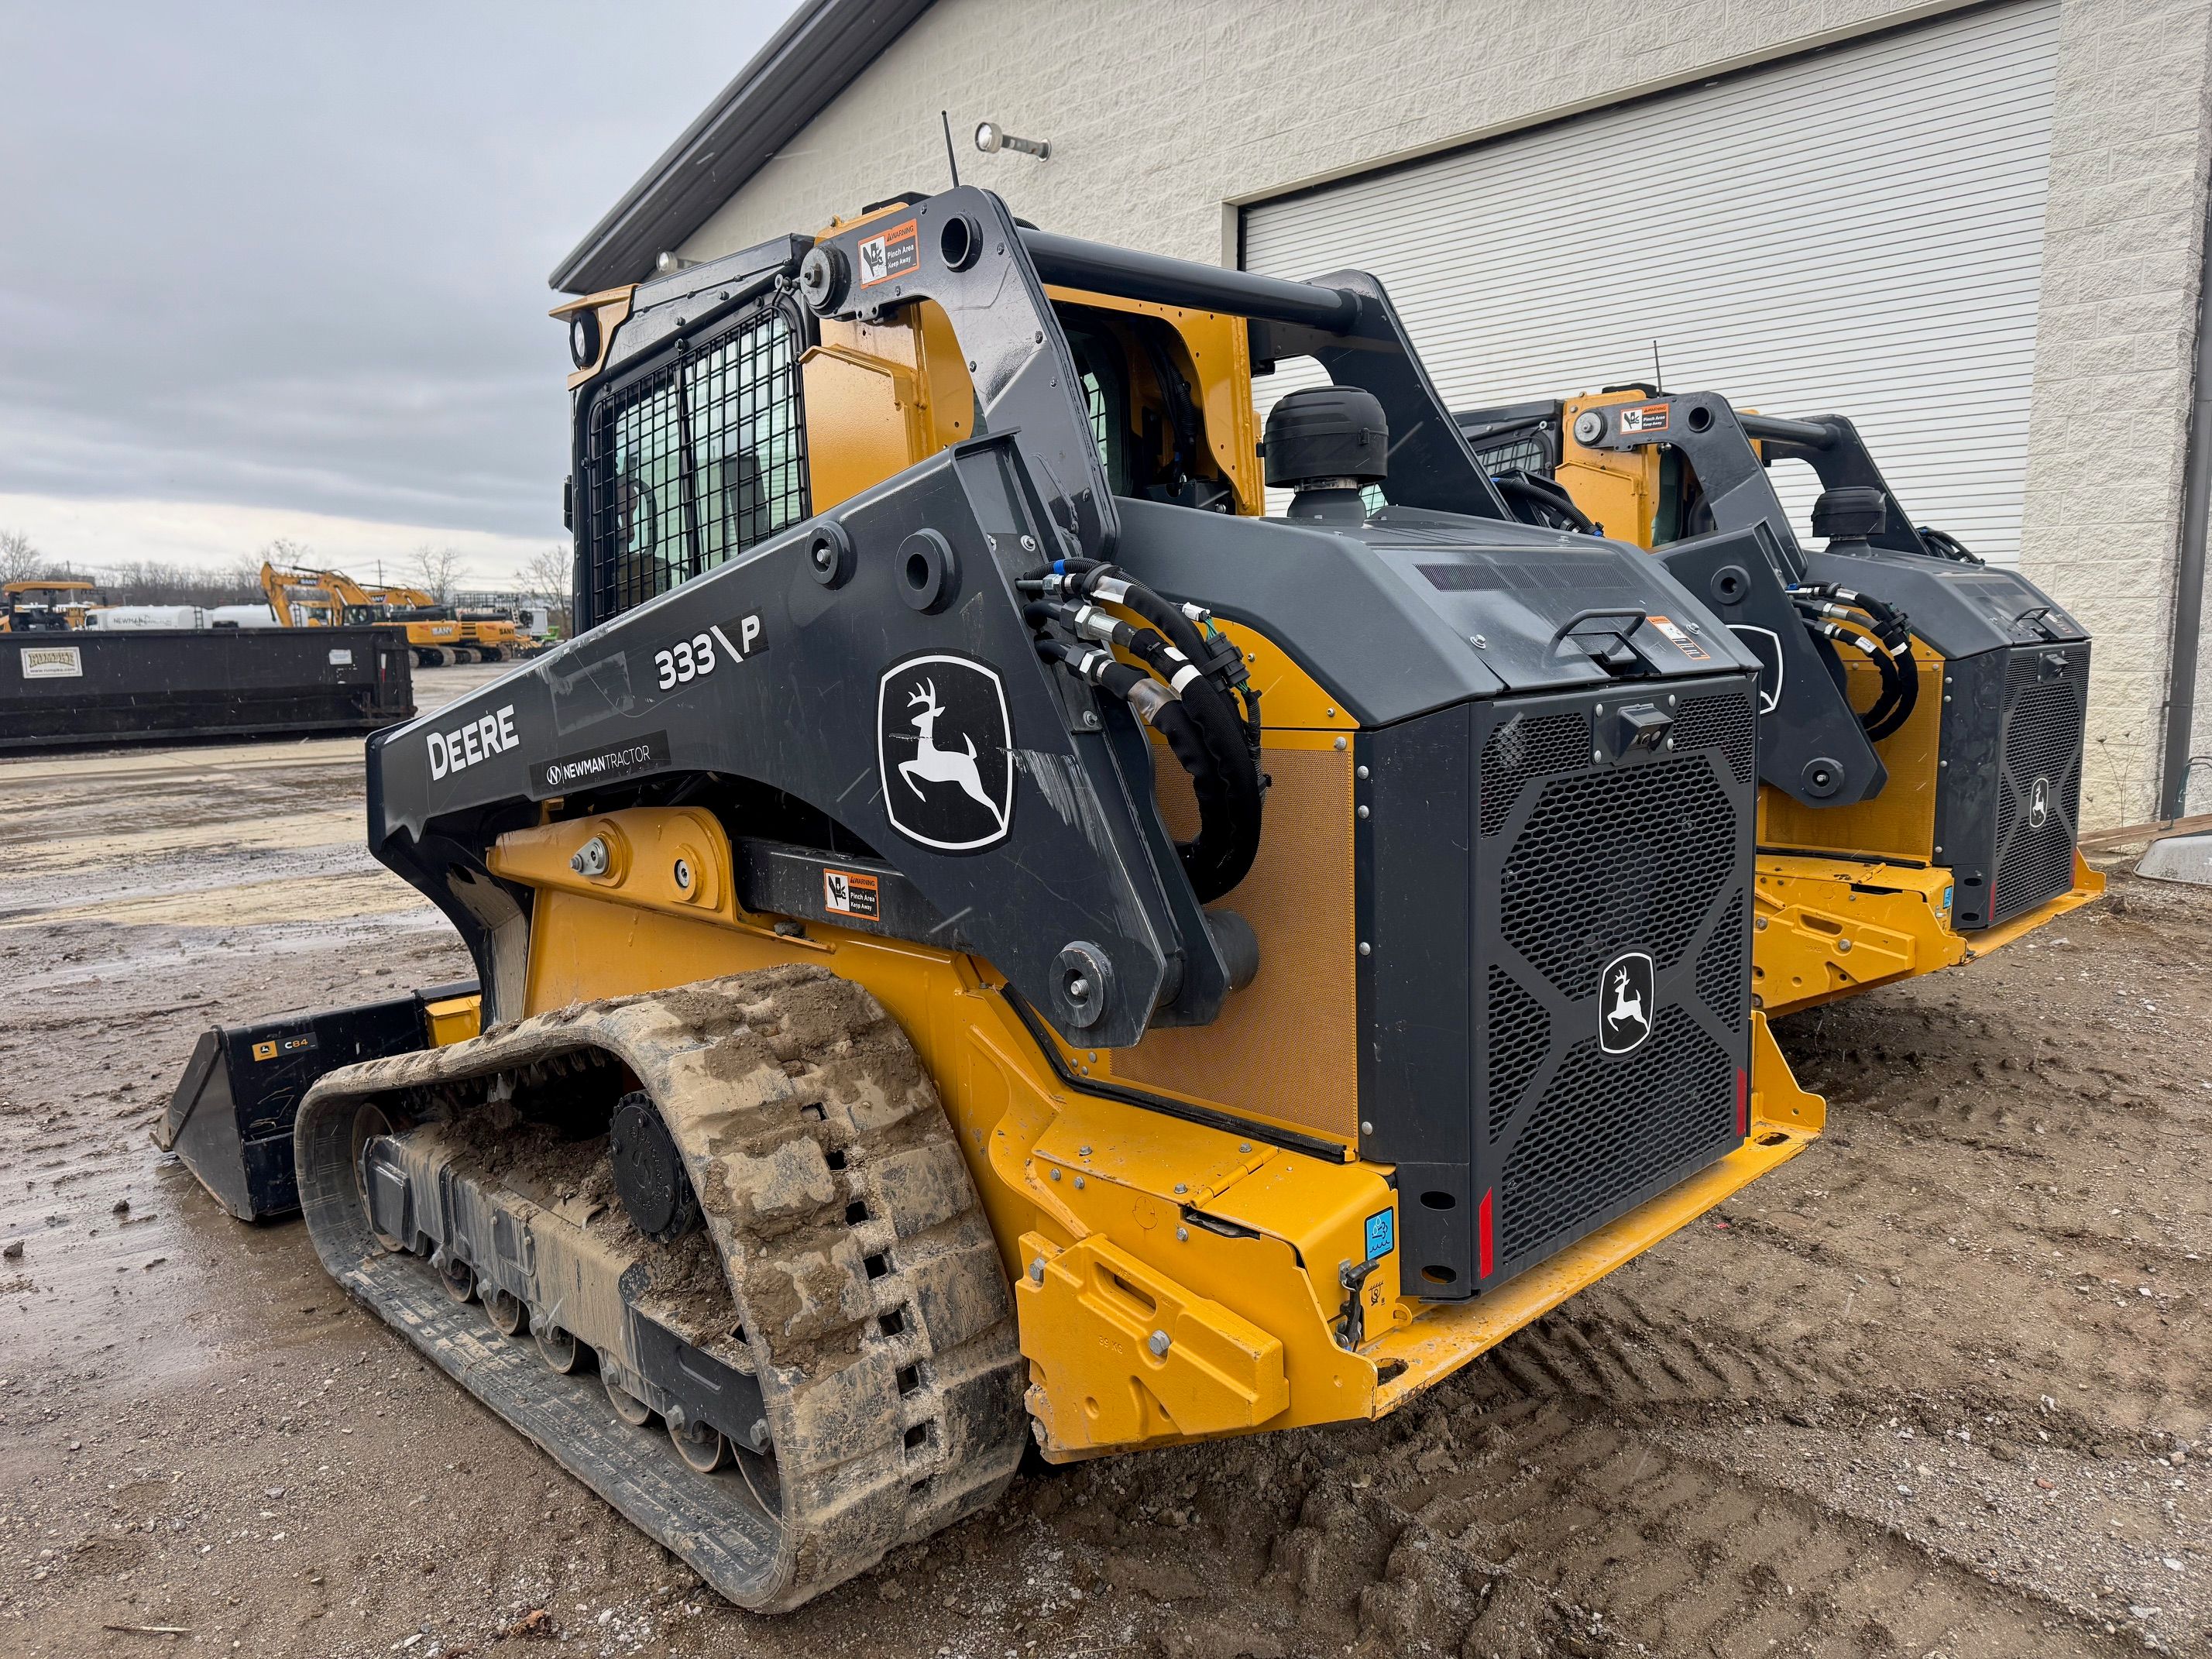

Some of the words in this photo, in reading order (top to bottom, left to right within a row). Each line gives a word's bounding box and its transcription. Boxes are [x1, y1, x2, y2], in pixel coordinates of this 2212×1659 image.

[891, 225, 914, 239] WARNING
[887, 248, 902, 259] Pinch
[902, 245, 914, 254] Area
[426, 704, 520, 781] DEERE
[854, 878, 875, 887] WARNING
[850, 892, 864, 901] Pinch
[284, 1039, 308, 1049] C84
